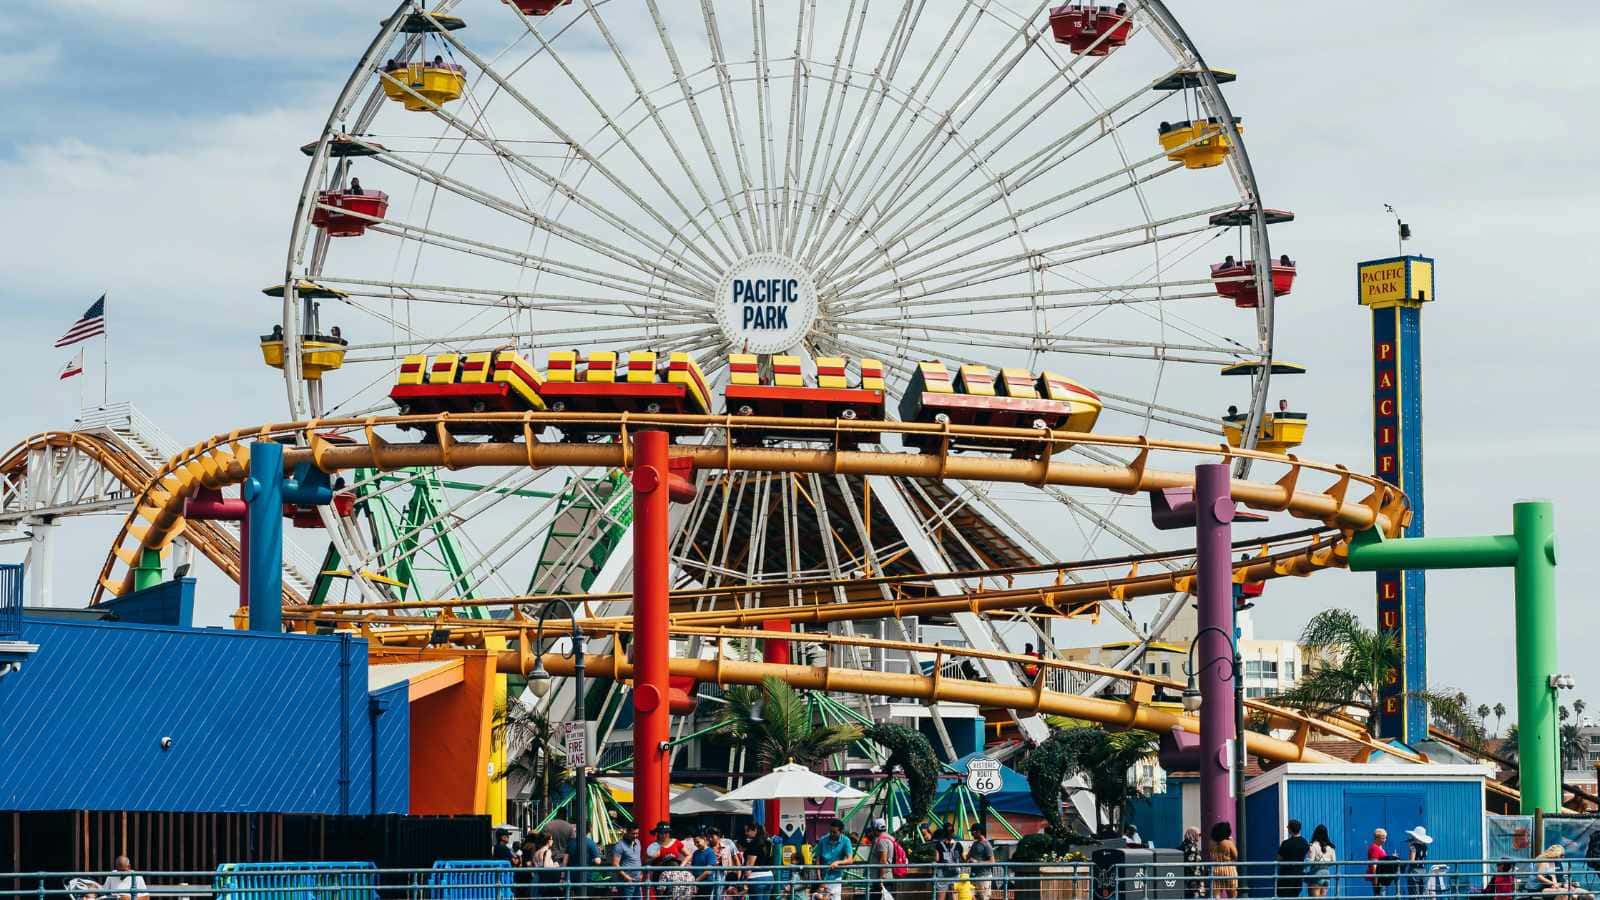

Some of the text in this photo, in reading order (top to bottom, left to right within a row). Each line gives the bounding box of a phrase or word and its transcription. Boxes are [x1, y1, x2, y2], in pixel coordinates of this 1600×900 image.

[1362, 267, 1404, 283] PACIFIC
[733, 279, 798, 303] PACIFIC
[1368, 282, 1398, 295] PARK
[743, 305, 788, 330] PARK
[568, 740, 583, 753] FIRE
[567, 753, 585, 766] LANE
[976, 778, 994, 790] 66
